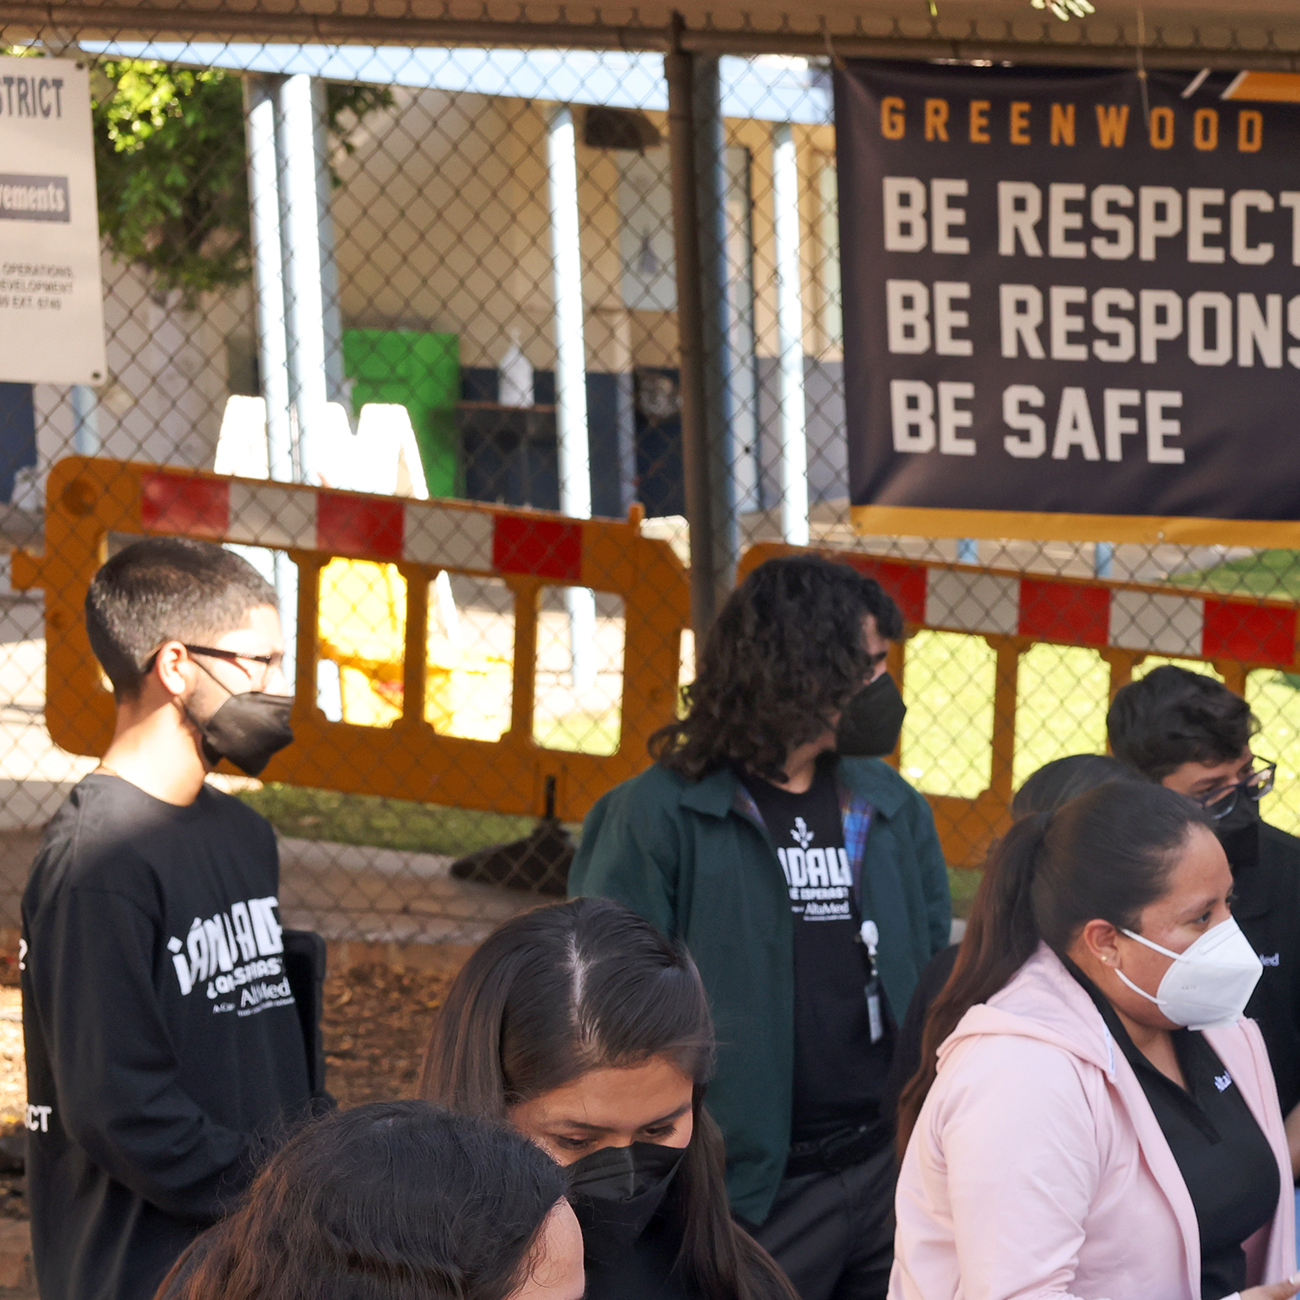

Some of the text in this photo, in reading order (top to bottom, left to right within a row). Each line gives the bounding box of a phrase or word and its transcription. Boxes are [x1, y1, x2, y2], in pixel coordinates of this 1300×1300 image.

[881, 96, 1264, 153] GREENWOOD
[882, 176, 970, 255] BE
[886, 278, 973, 356] BE
[889, 379, 1186, 465] BE SAFE
